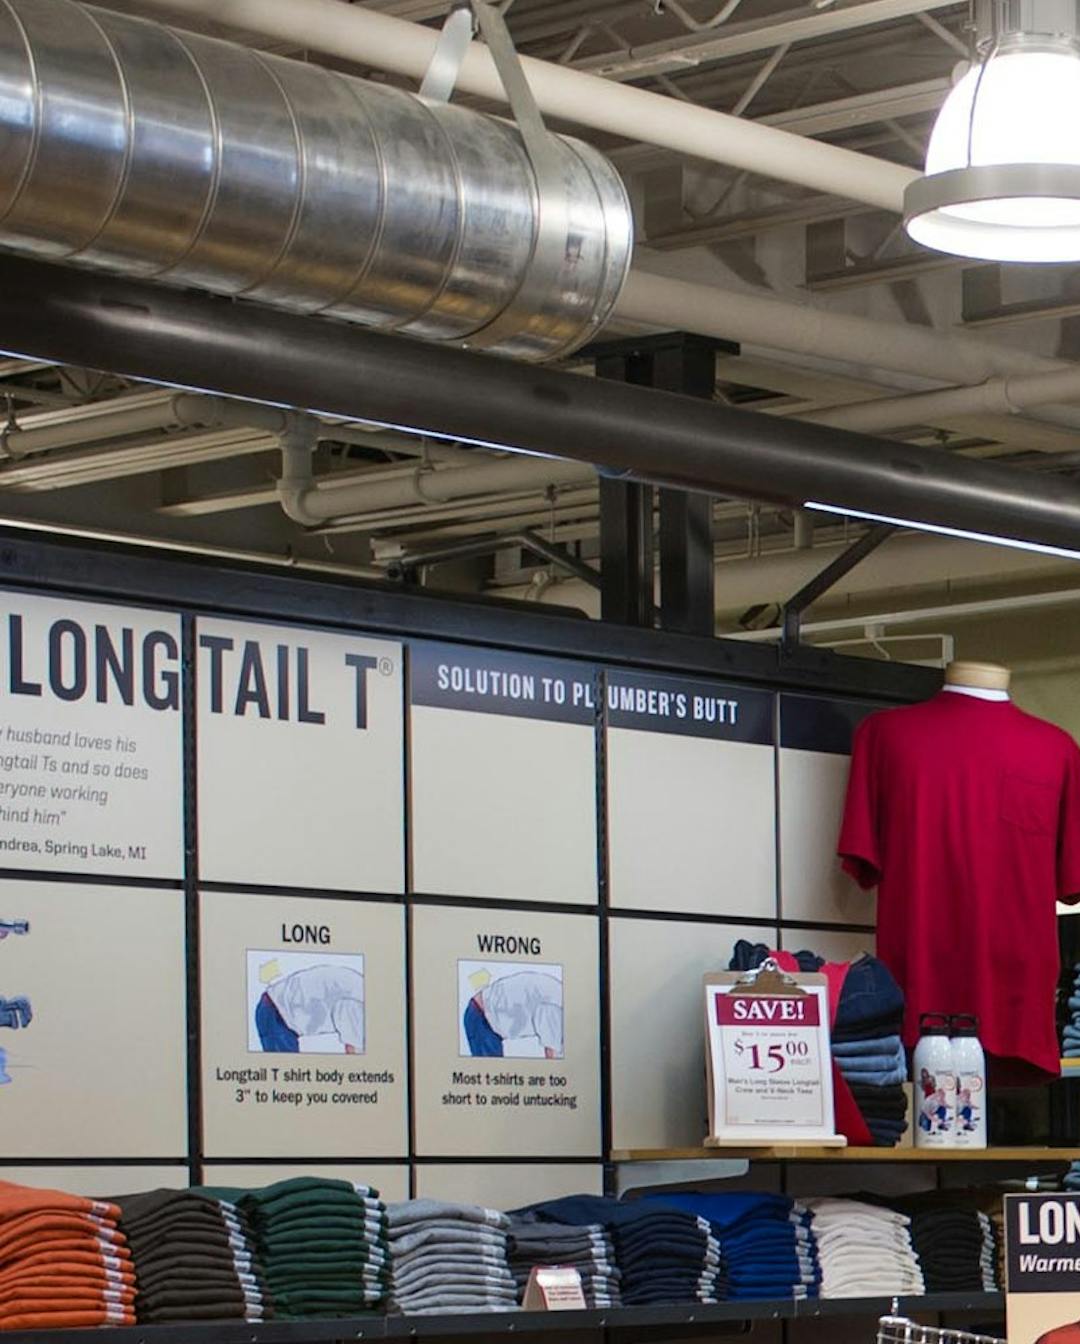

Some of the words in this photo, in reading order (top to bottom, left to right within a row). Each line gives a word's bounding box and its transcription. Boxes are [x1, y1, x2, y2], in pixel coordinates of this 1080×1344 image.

[437, 664, 534, 700] SOLUTION
[542, 678, 565, 704] TO
[694, 697, 738, 724] BUTT
[6, 726, 72, 747] husband
[74, 732, 112, 751] loves
[116, 736, 137, 753] his
[42, 755, 57, 772] Ts
[61, 760, 90, 775] and
[92, 763, 111, 777] so
[114, 762, 149, 780] does
[50, 785, 109, 806] working
[45, 839, 88, 859] Spring
[92, 844, 126, 860] Lake,
[128, 846, 147, 860] MI
[282, 923, 331, 945] LONG
[477, 934, 541, 956] WRONG
[733, 999, 804, 1020] SAVE!
[216, 1067, 267, 1084] Longtail
[272, 1069, 279, 1081] T
[284, 1069, 312, 1082] shirt
[316, 1069, 344, 1085] body
[348, 1071, 395, 1083] extends
[452, 1072, 482, 1085] Most
[486, 1072, 524, 1086] t-shirts
[528, 1075, 546, 1086] are
[549, 1075, 567, 1086] too
[256, 1090, 268, 1103] to
[272, 1090, 303, 1106] keep
[306, 1092, 328, 1106] you
[332, 1091, 378, 1104] covered
[442, 1092, 471, 1105] short
[475, 1094, 487, 1105] to
[491, 1092, 520, 1106] avoid
[523, 1093, 577, 1109] untucking
